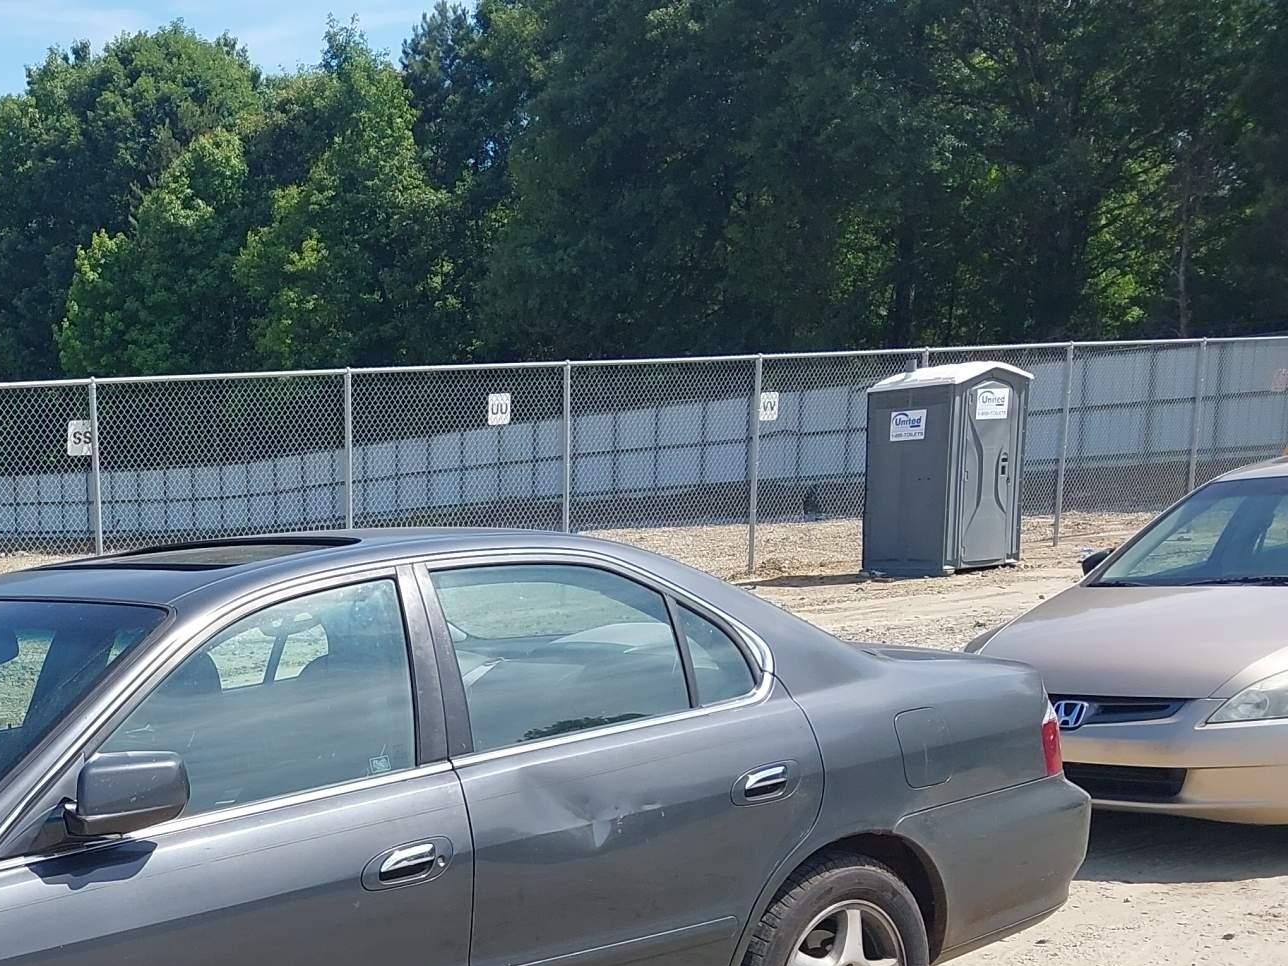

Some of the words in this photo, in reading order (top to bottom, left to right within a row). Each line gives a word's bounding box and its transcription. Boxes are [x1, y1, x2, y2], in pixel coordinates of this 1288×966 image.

[491, 403, 508, 415] UU
[895, 416, 922, 426] United
[72, 431, 92, 445] SS
